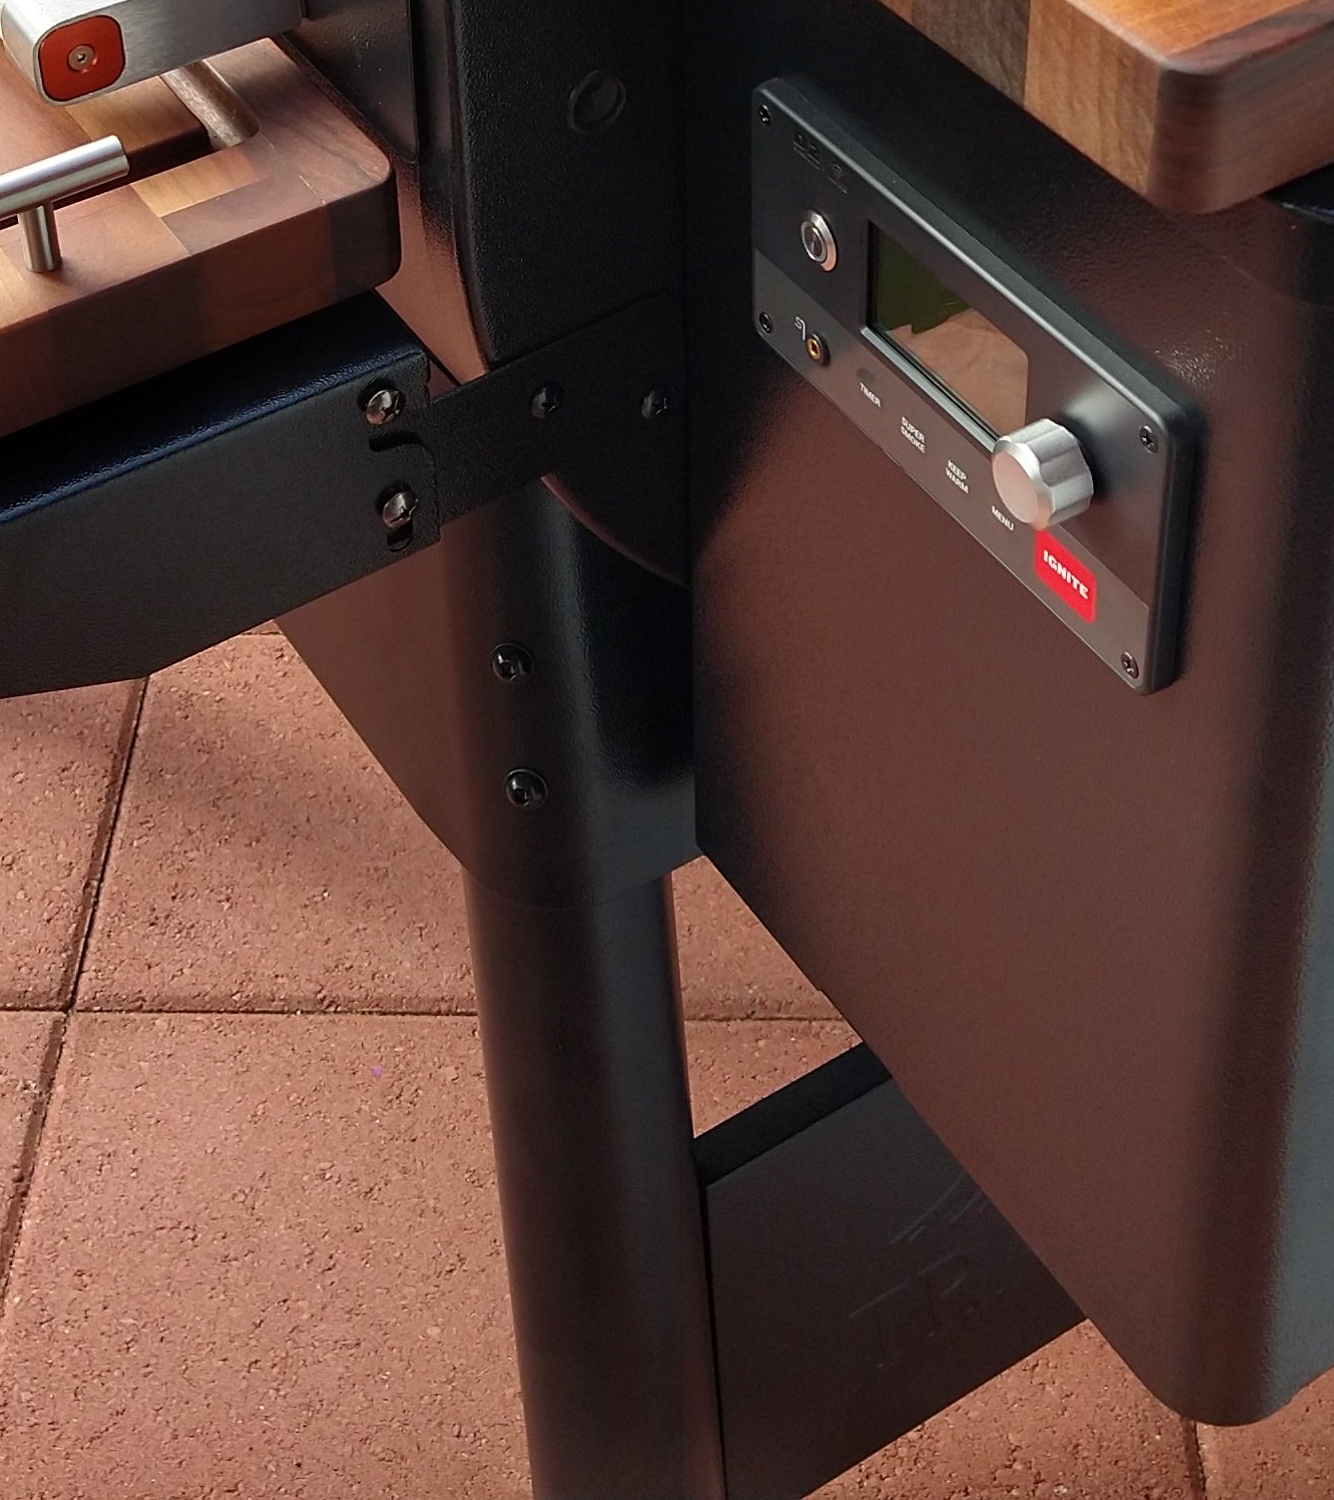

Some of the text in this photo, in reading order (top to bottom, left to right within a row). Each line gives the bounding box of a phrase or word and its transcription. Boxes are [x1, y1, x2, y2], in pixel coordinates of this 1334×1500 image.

[859, 382, 881, 408] TIMER
[900, 425, 926, 454] SMOKE
[901, 416, 925, 444] SUPER
[945, 467, 969, 494] WARM
[947, 460, 968, 481] KEEP
[991, 505, 1014, 531] MENU
[1043, 549, 1089, 600] IGNITE
